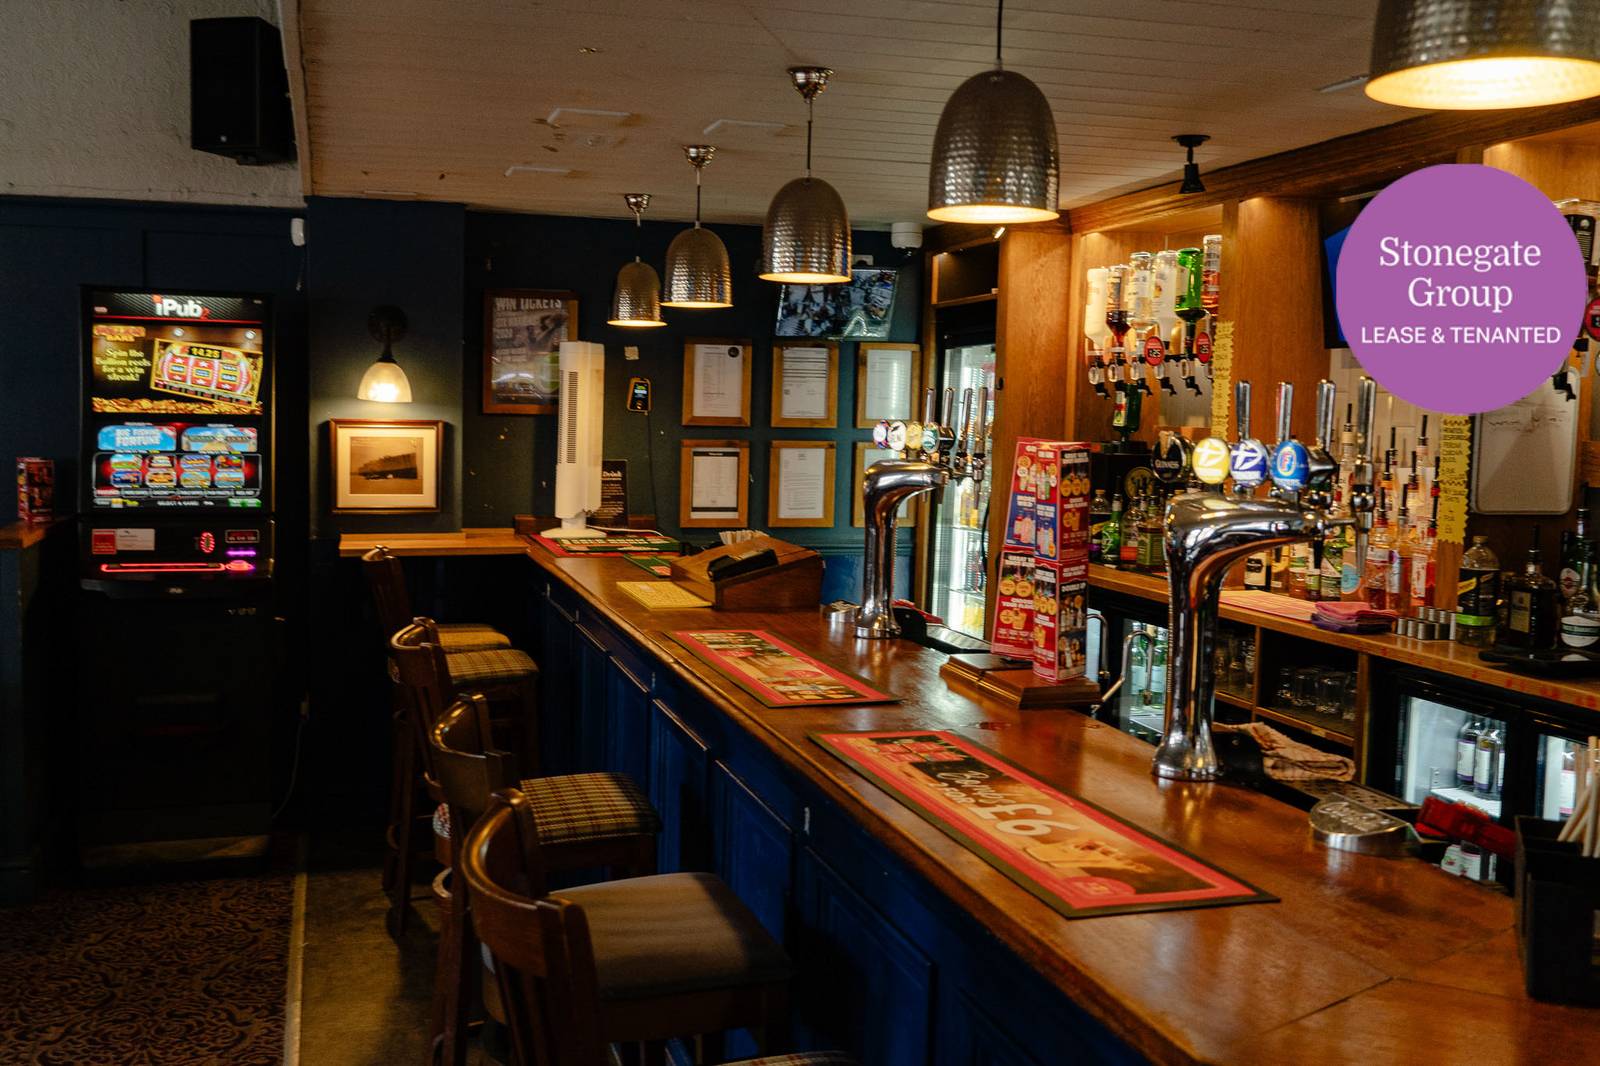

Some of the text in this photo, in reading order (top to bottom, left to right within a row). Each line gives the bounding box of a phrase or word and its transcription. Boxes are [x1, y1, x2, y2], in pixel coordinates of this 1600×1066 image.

[936, 770, 1017, 805] Bombs
[938, 787, 977, 805] FOR
[968, 803, 1081, 837] £6
